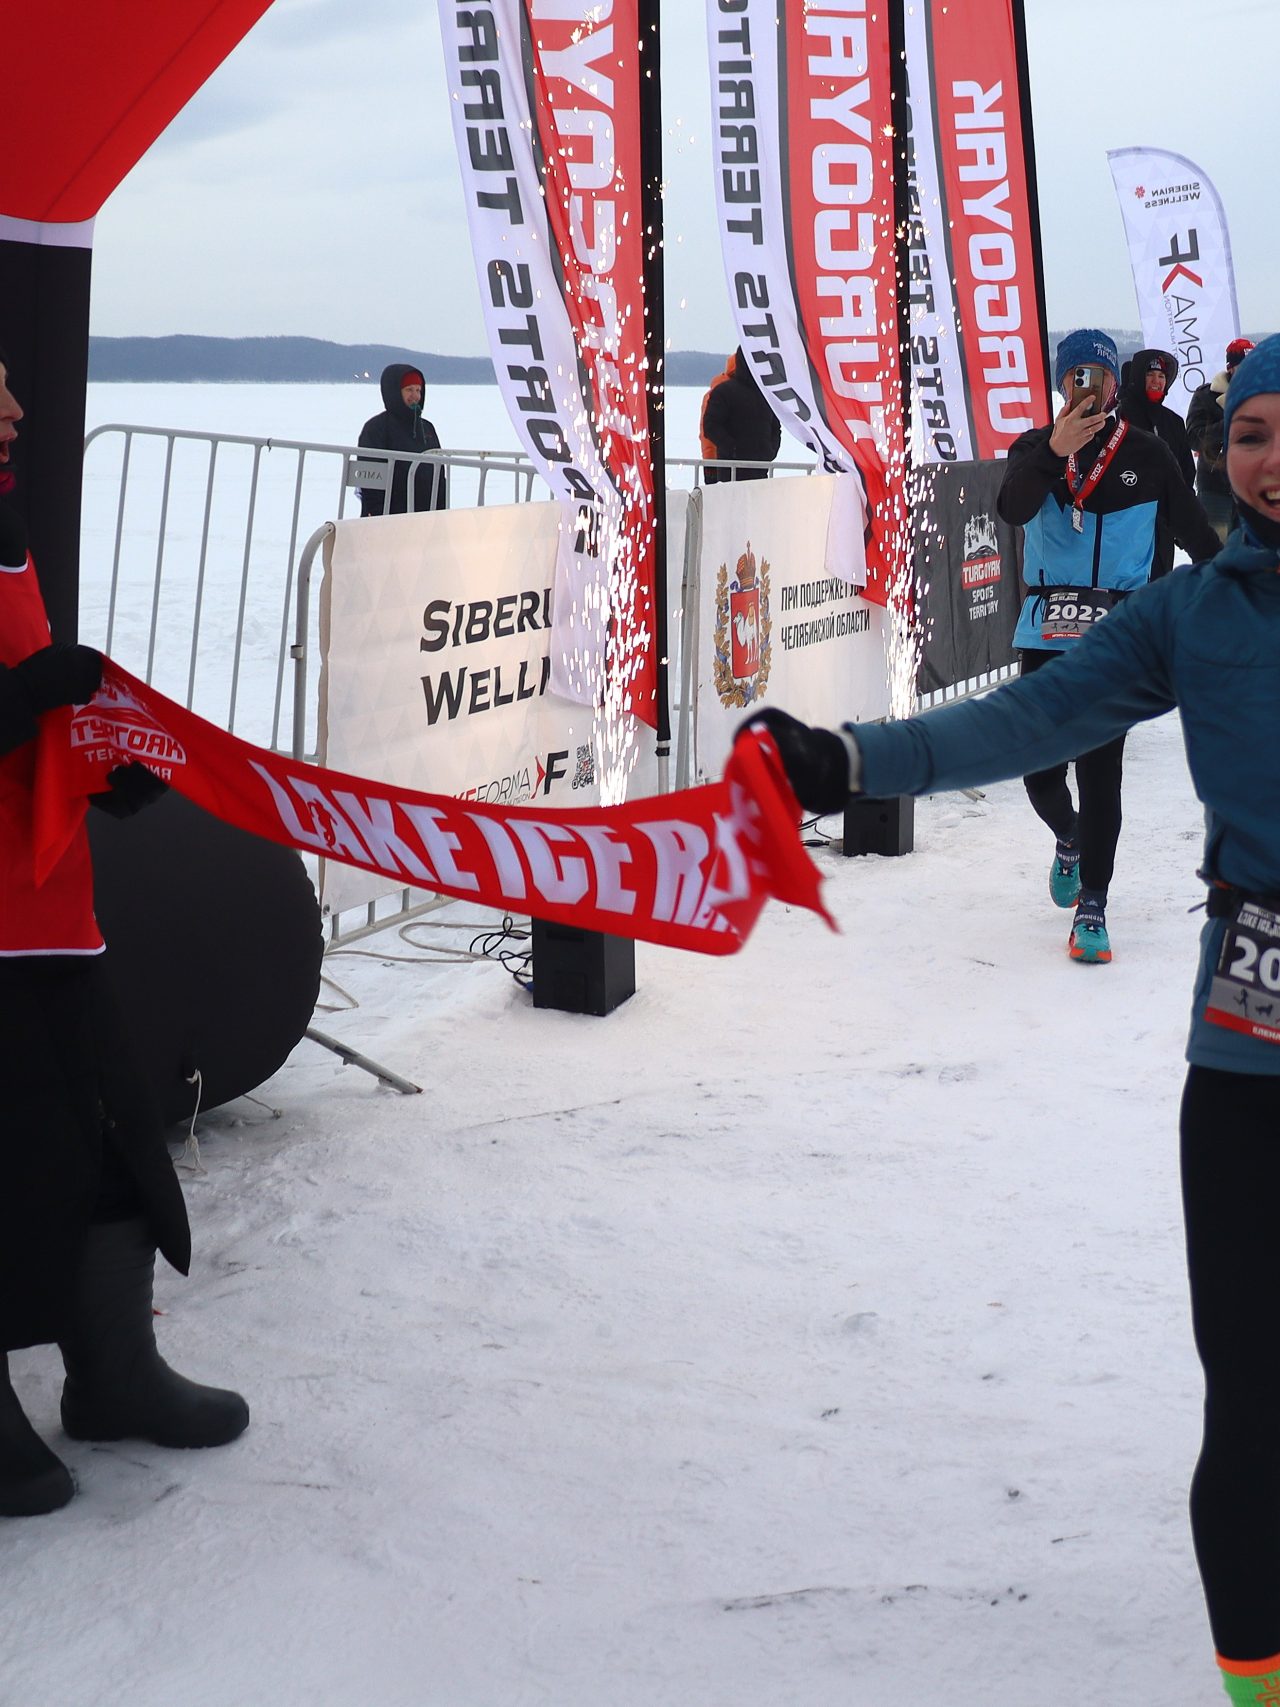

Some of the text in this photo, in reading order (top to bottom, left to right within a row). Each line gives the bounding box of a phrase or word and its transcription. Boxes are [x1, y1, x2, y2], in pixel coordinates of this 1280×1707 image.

[781, 585, 799, 612] ПРИ
[799, 578, 844, 608] ПОДДЕРЖКЕ
[781, 608, 870, 651] ЧЕЛЯБИНСКОЙ ОБЛАСТИ
[247, 758, 480, 893] LAKE
[463, 811, 636, 916] ICE
